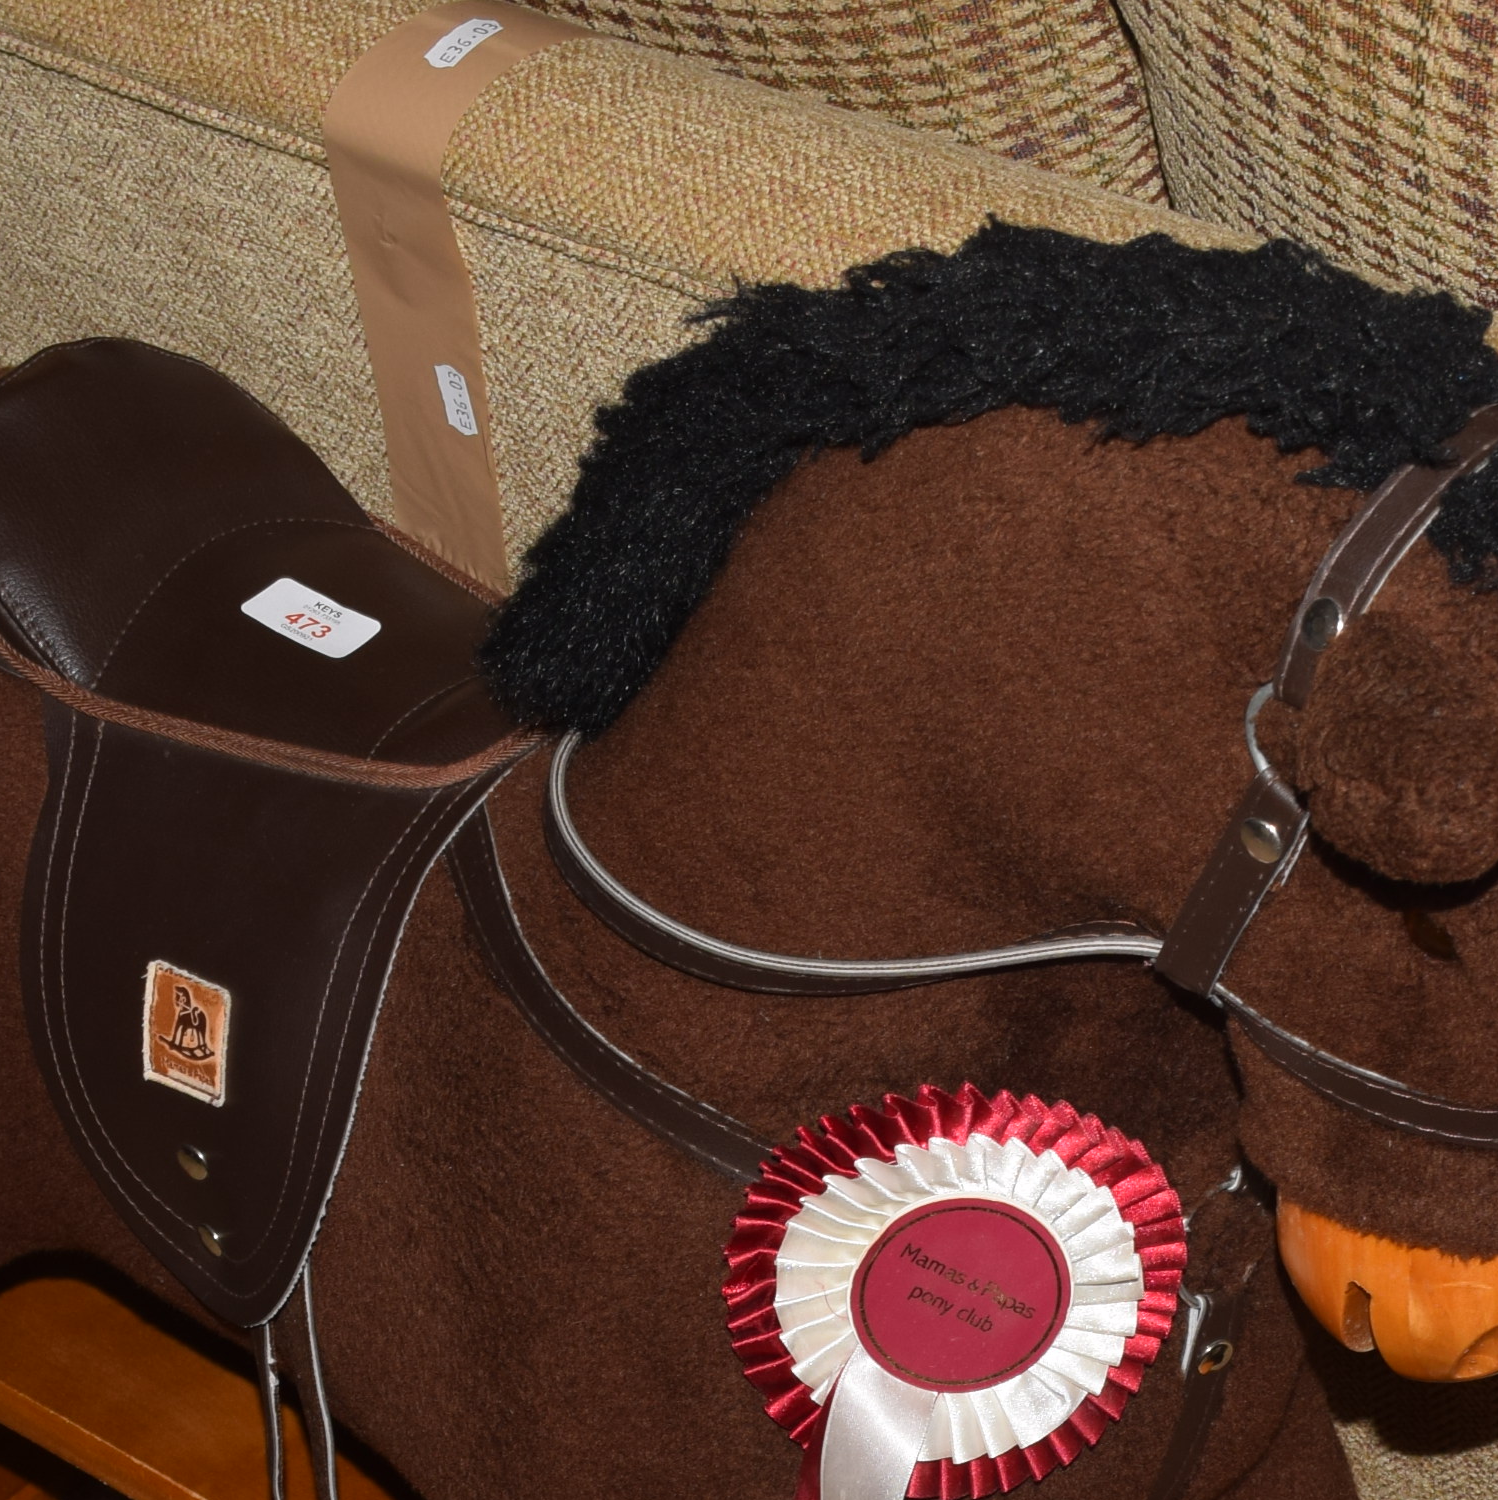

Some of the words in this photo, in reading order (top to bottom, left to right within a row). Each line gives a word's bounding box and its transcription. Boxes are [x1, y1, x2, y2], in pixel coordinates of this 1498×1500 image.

[284, 613, 332, 638] 473
[313, 601, 343, 618] KEYS
[900, 1242, 967, 1285] Mamas
[967, 1278, 980, 1292] &
[907, 1285, 955, 1316] pony
[956, 1307, 994, 1333] club
